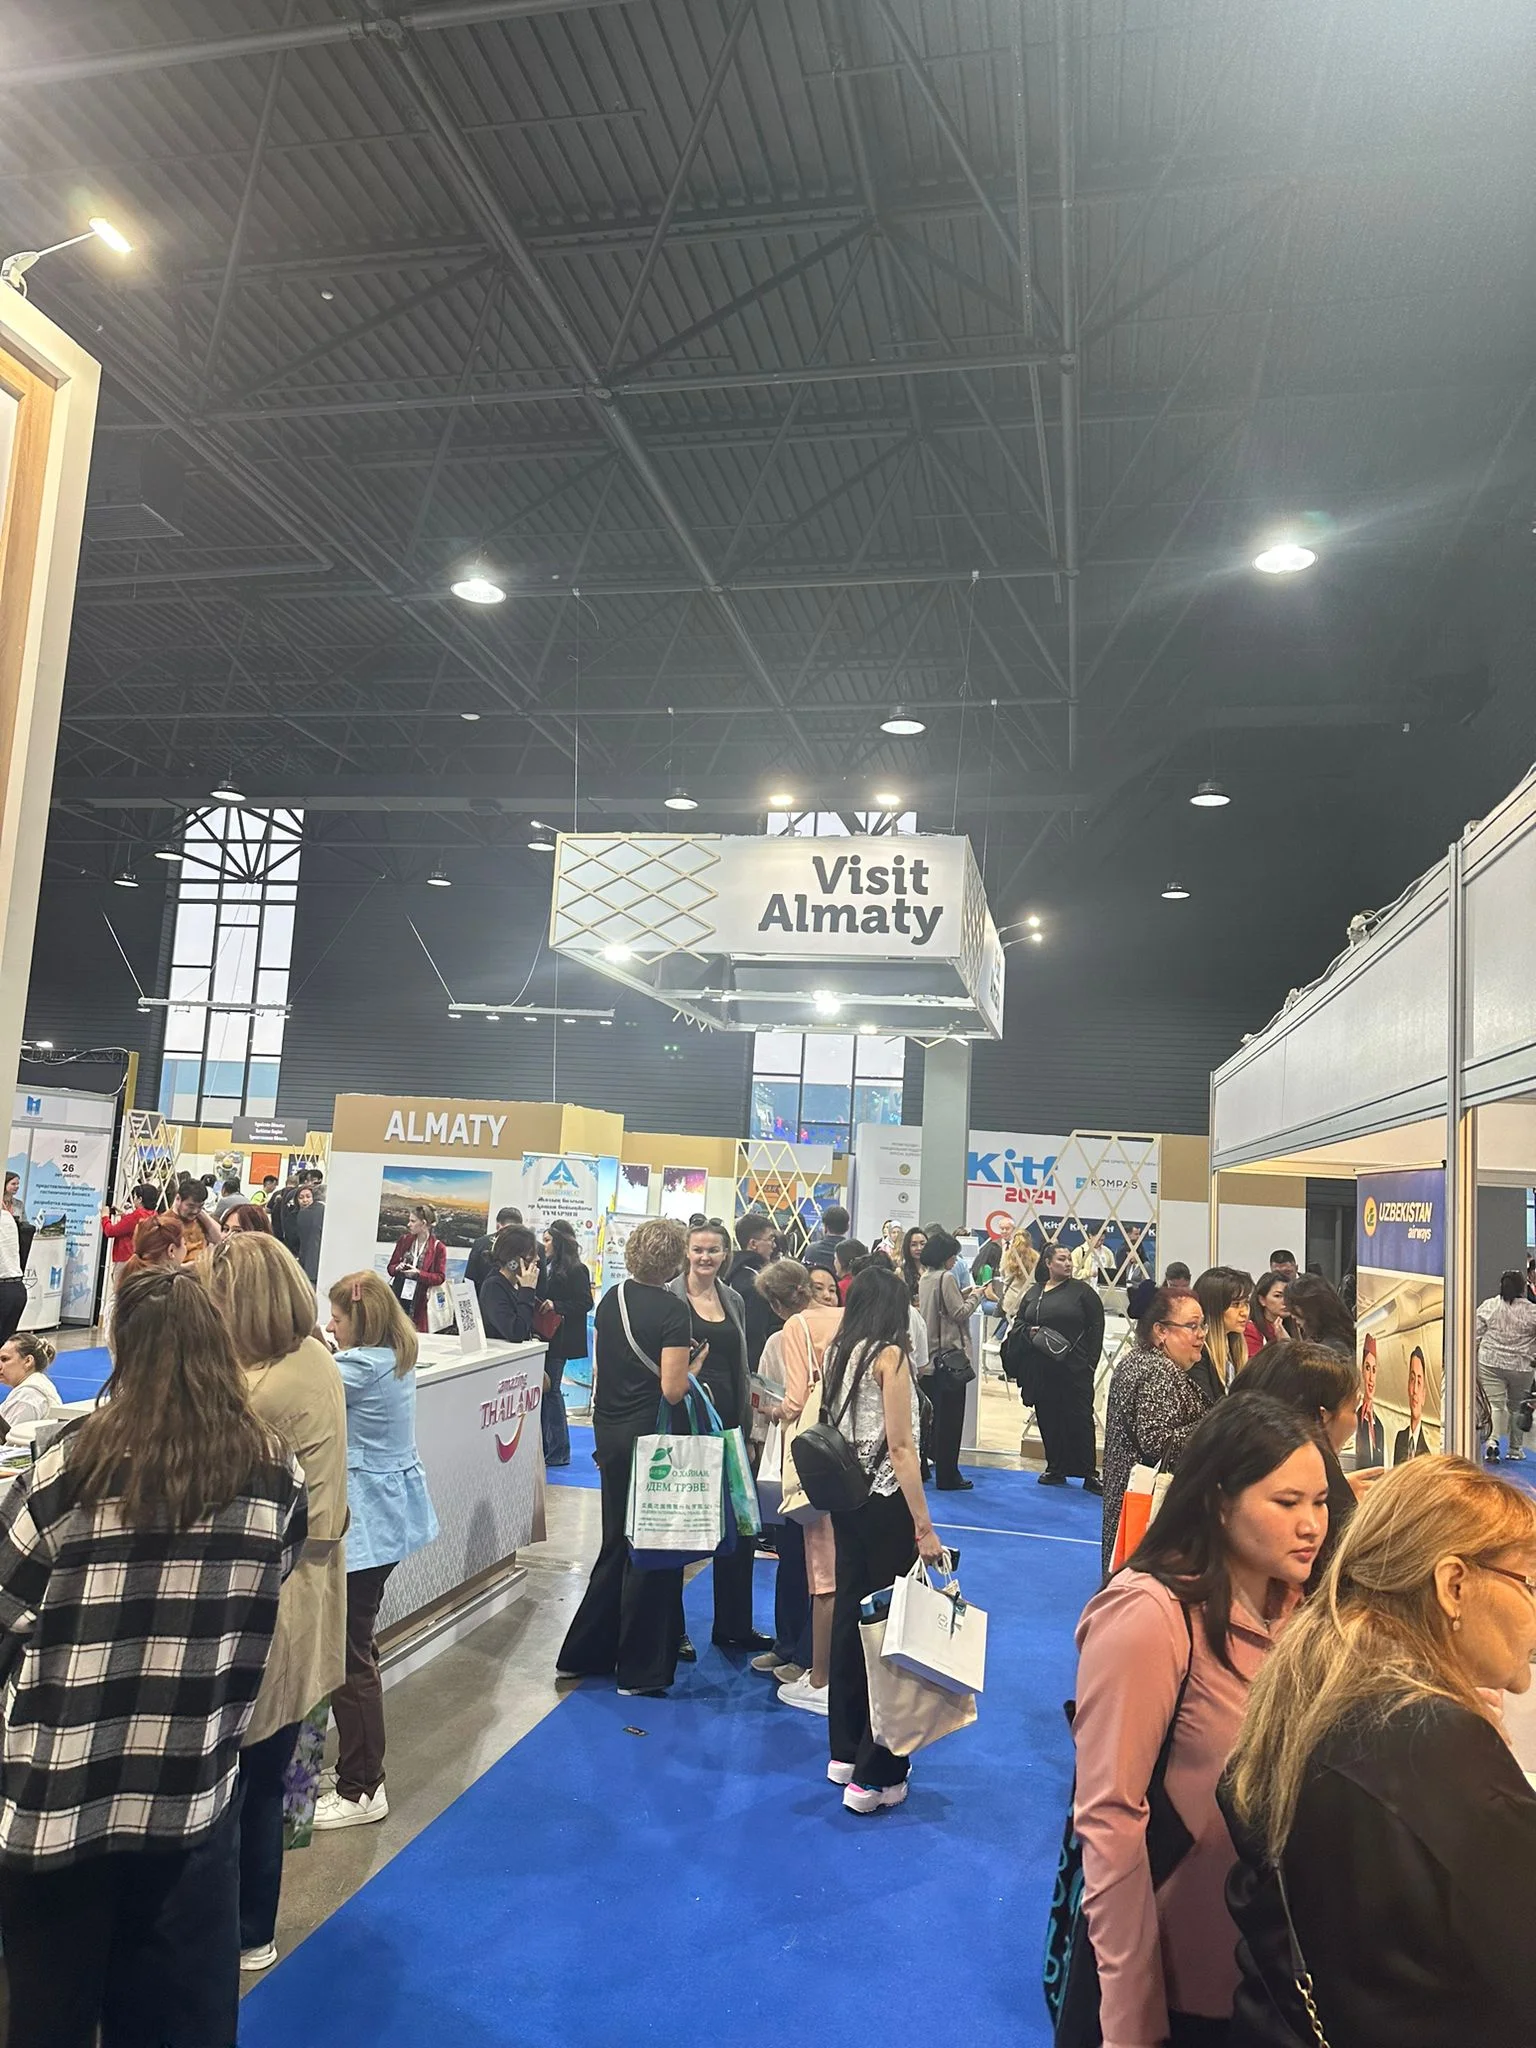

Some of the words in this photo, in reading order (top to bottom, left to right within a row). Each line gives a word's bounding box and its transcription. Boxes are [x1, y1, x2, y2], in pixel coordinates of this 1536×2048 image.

[812, 854, 929, 895] Visit
[757, 893, 944, 945] Almaty
[383, 1110, 508, 1147] ALMATY
[63, 1144, 77, 1154] 80
[62, 1163, 75, 1173] 26
[967, 1148, 1058, 1187] Kitf
[1090, 1178, 1138, 1190] KOMPAS
[1004, 1187, 1056, 1205] 2024
[1378, 1202, 1433, 1223] UZBEKISTAN
[1407, 1224, 1432, 1243] airways
[480, 1385, 541, 1430] THAILAND
